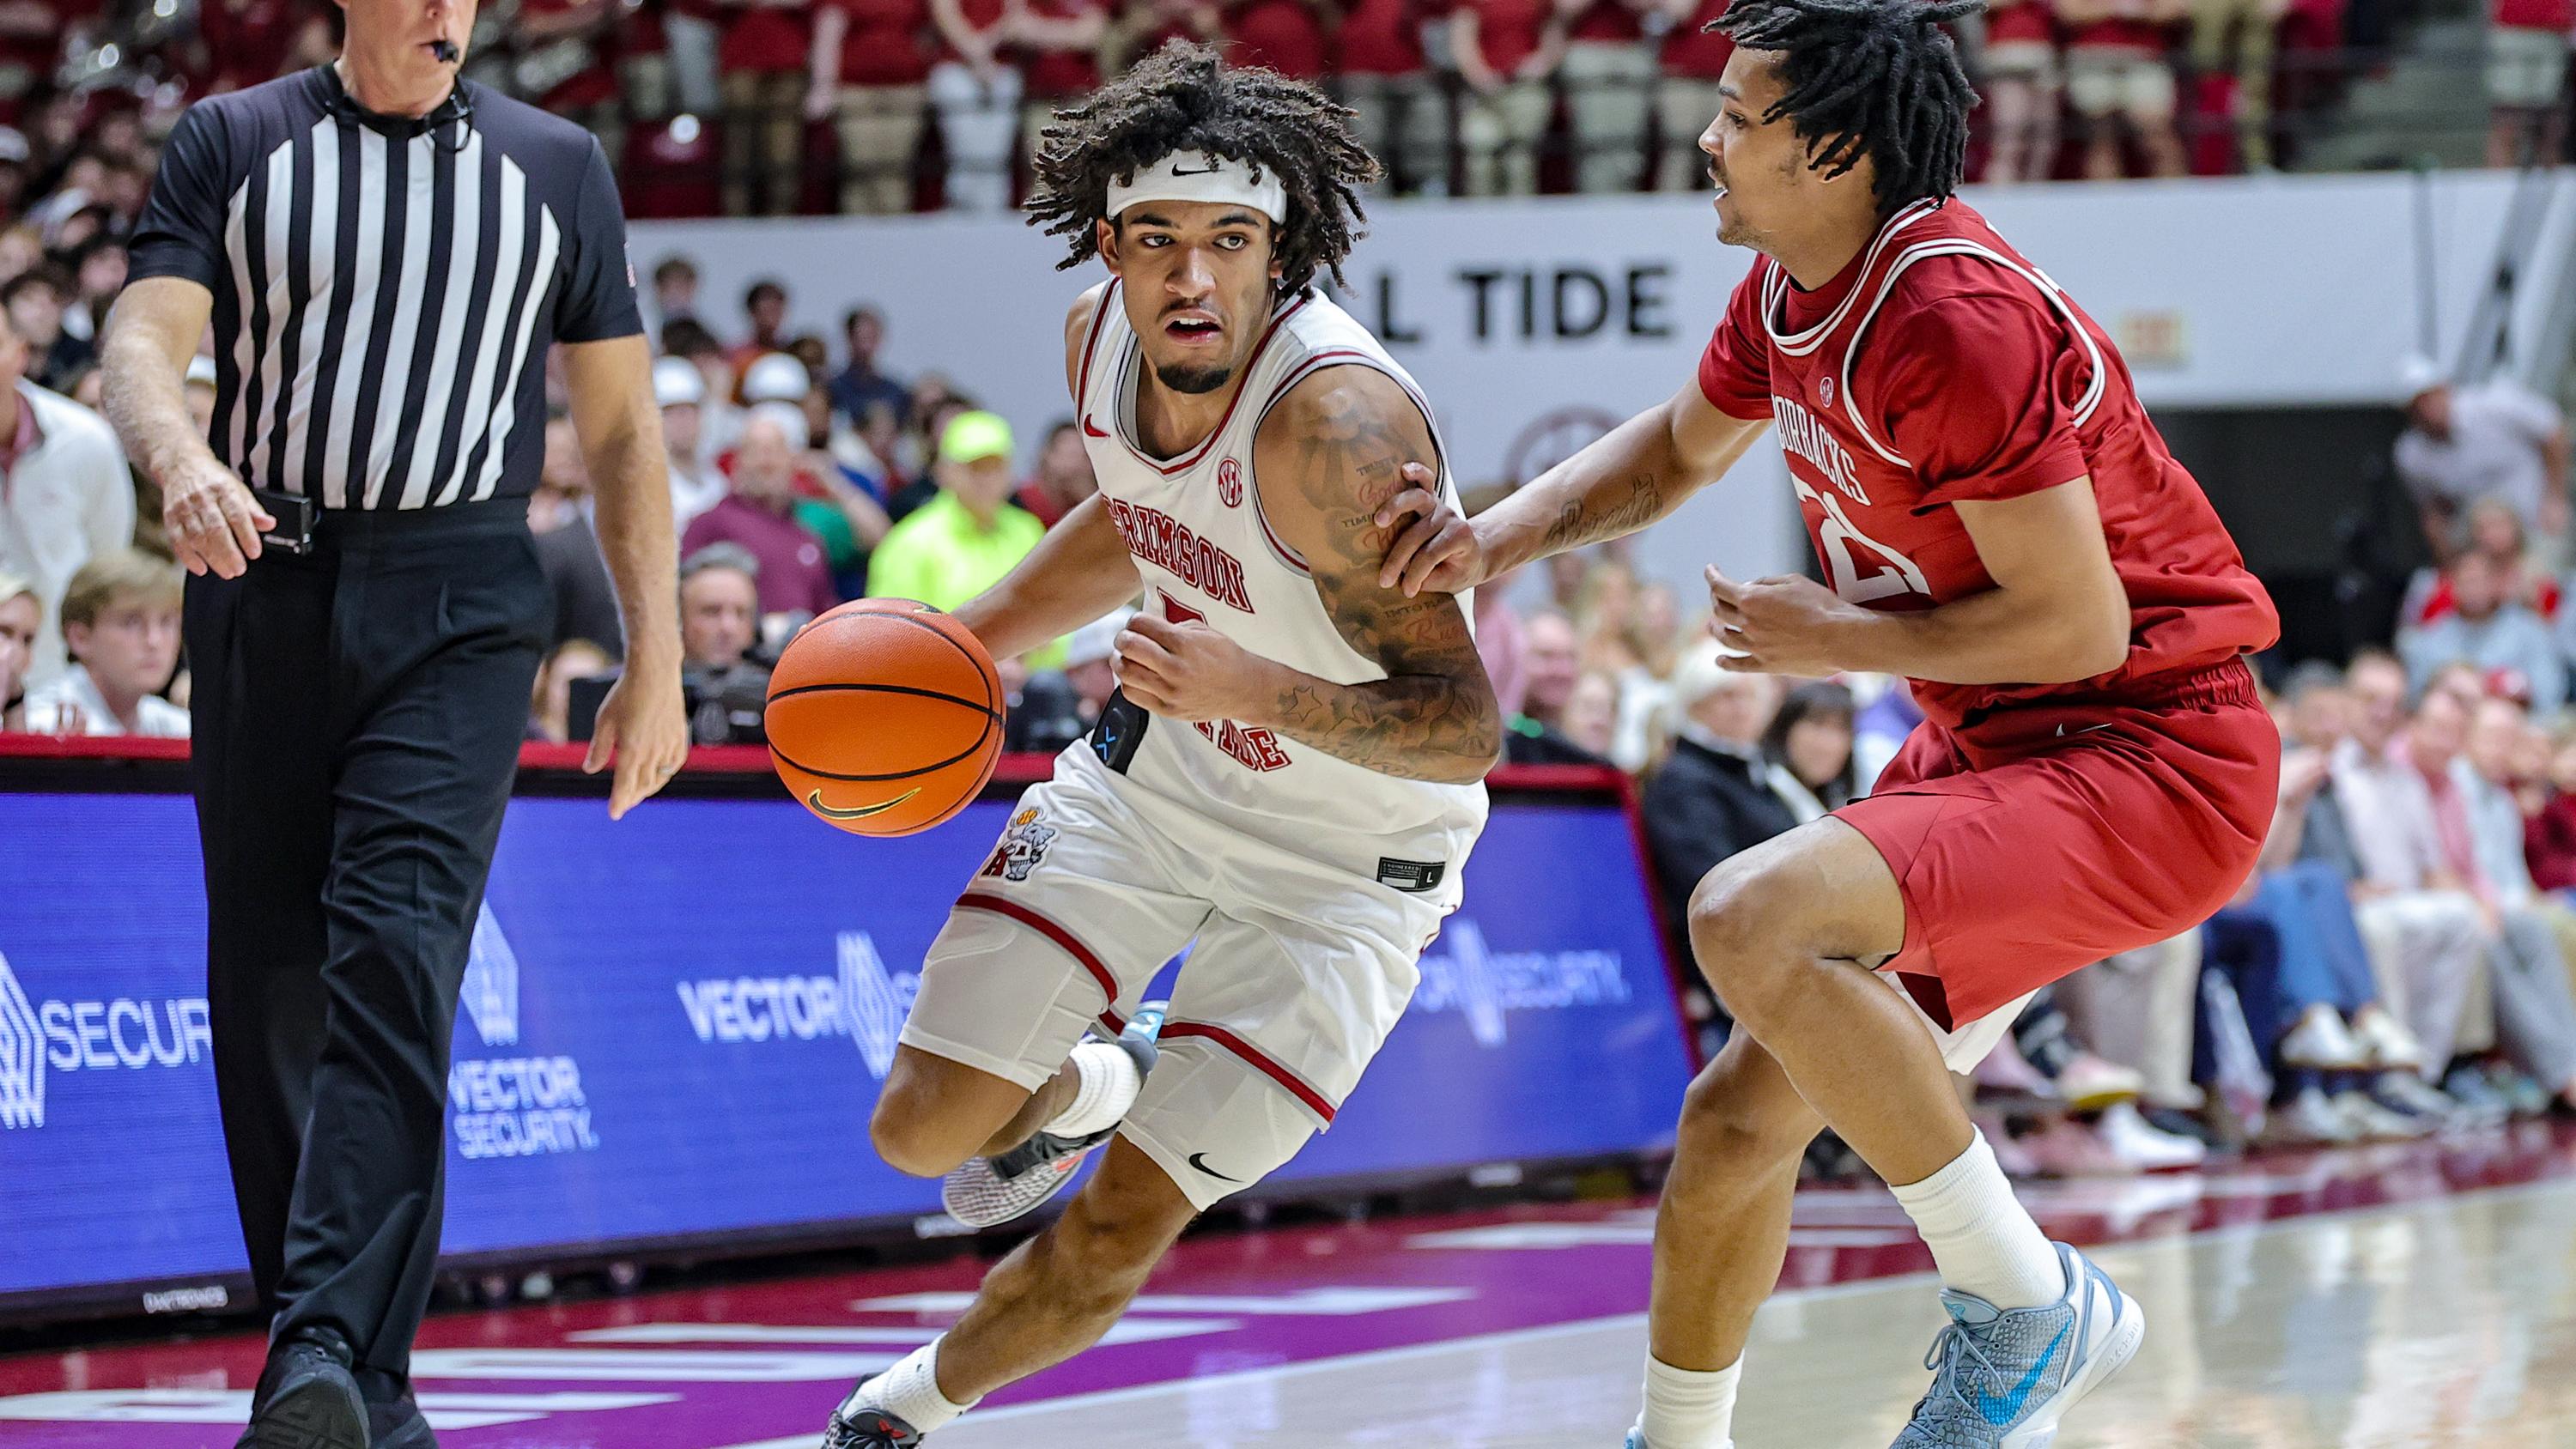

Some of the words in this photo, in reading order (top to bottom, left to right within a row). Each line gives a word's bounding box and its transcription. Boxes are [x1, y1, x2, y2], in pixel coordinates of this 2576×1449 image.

[1455, 268, 1671, 341] TIDE
[1771, 393, 1871, 506] ORBACKS
[1426, 872, 1433, 883] L
[676, 974, 850, 1043] VECTOR
